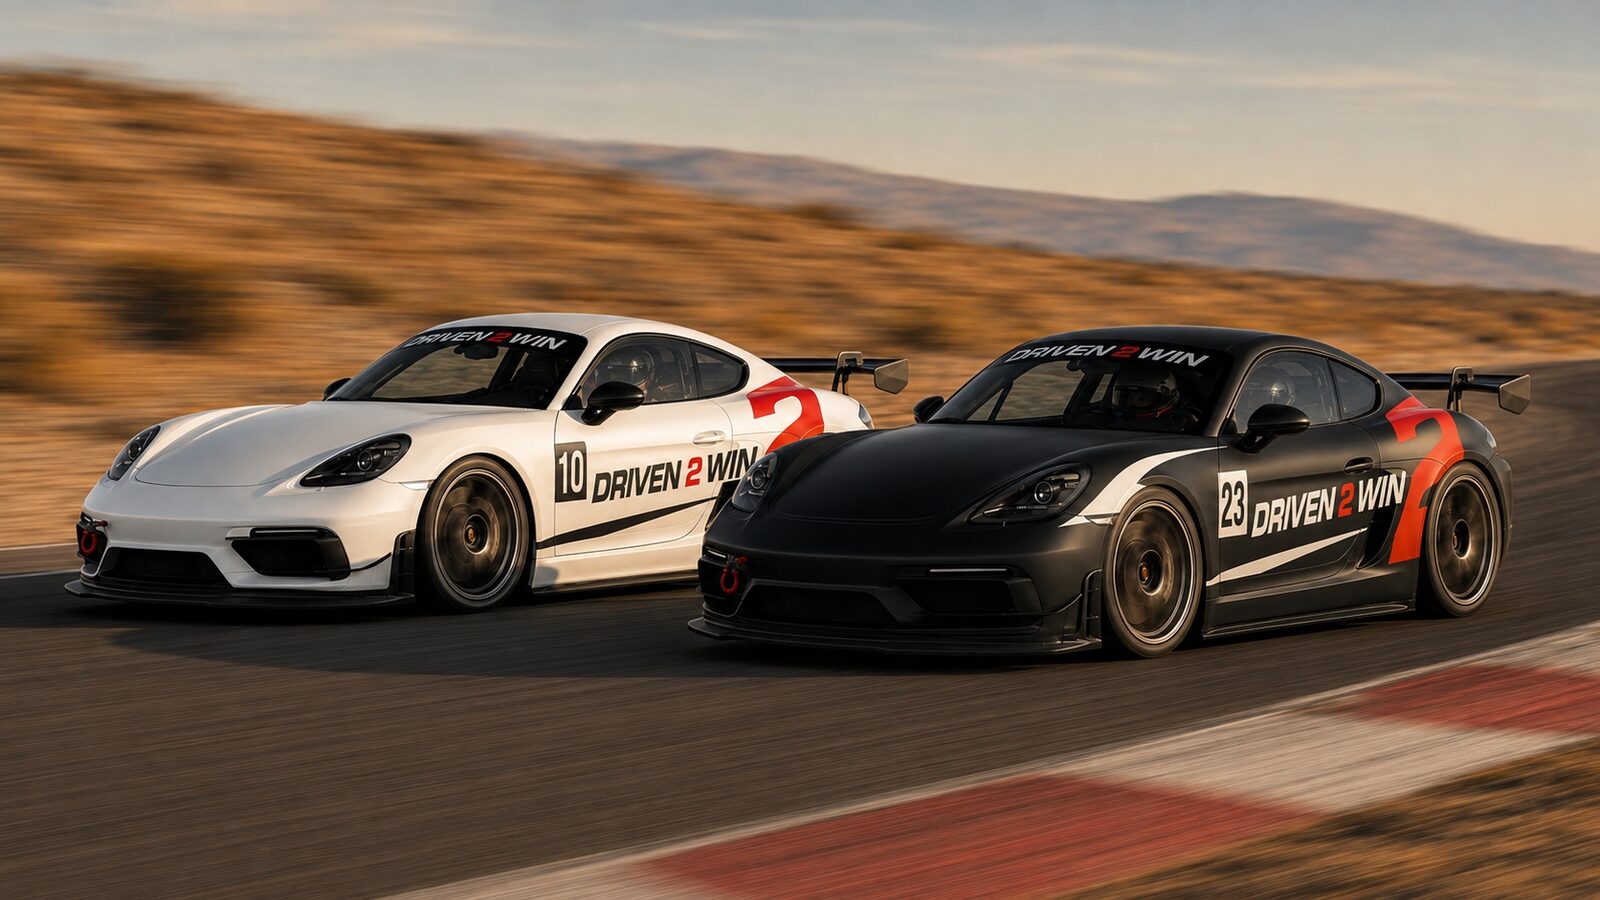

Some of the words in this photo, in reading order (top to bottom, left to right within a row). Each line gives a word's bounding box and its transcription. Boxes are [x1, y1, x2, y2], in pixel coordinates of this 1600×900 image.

[402, 331, 495, 348] DRIVEN
[487, 332, 512, 343] 2
[509, 333, 567, 350] WIN
[1004, 345, 1116, 363] DRIVEN
[1111, 346, 1140, 358] 2
[1138, 347, 1209, 367] WIN
[558, 450, 585, 495] 10
[591, 460, 682, 504] DRIVEN
[685, 456, 703, 488] 2
[707, 446, 759, 483] WIN
[1220, 480, 1245, 529] 23
[1250, 486, 1337, 538] DRIVEN
[1337, 482, 1355, 518] 2
[1357, 471, 1407, 513] WIN
